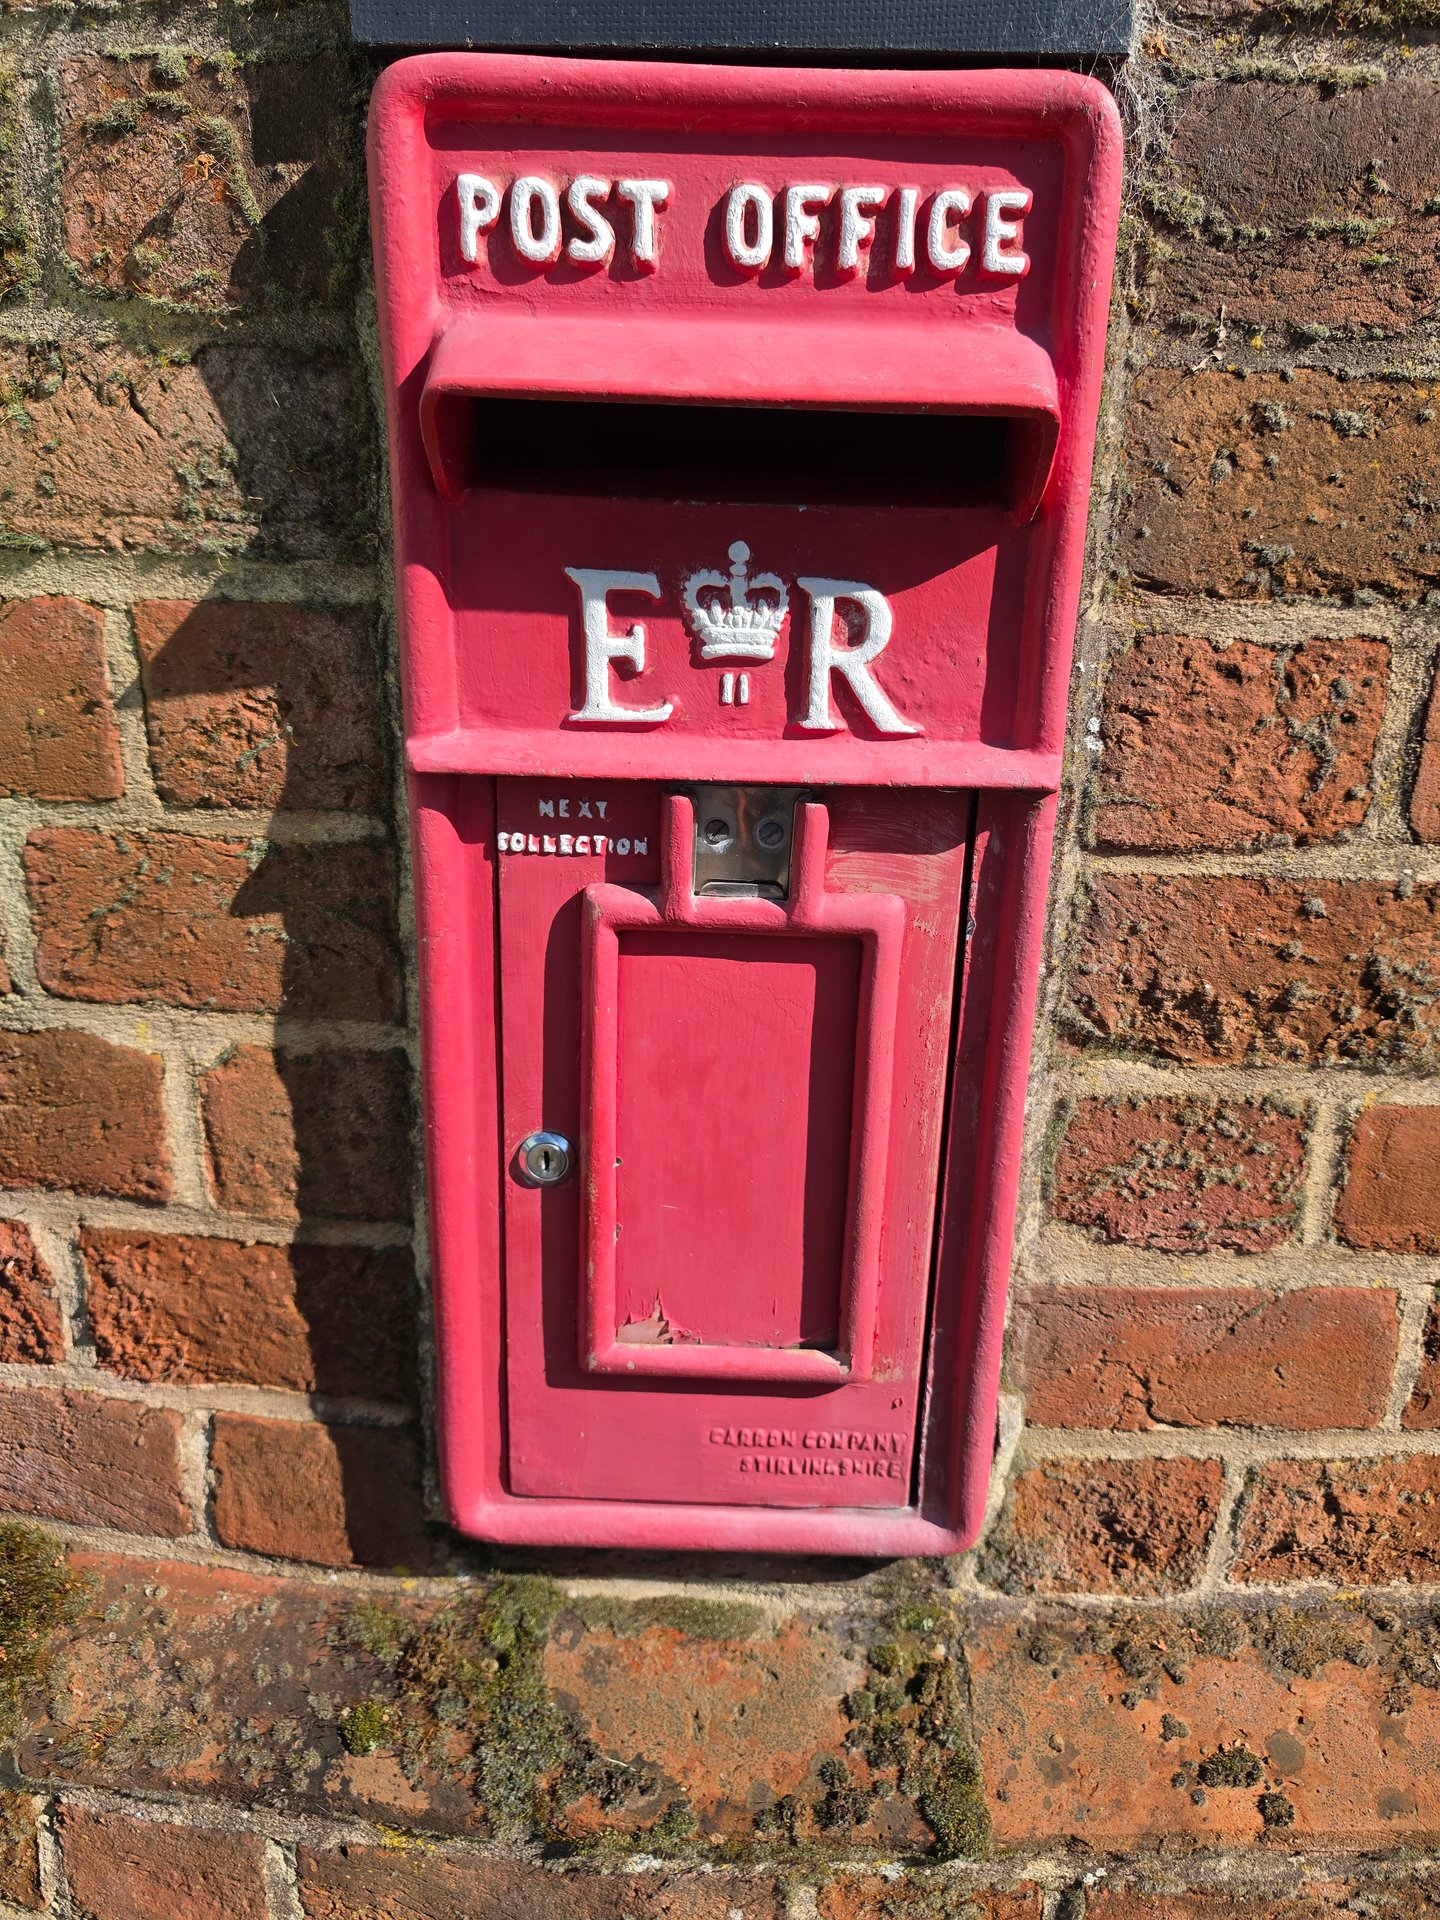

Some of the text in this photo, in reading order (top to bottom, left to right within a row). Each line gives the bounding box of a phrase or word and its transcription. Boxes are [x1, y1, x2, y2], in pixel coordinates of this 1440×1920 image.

[456, 172, 1032, 275] POST OFFICE
[564, 566, 920, 735] E R
[538, 798, 609, 819] NEXT
[497, 831, 649, 856] COLLECTION
[709, 1426, 907, 1454] CARRON COMPANY
[739, 1454, 905, 1480] STIRLINGSHIRE
